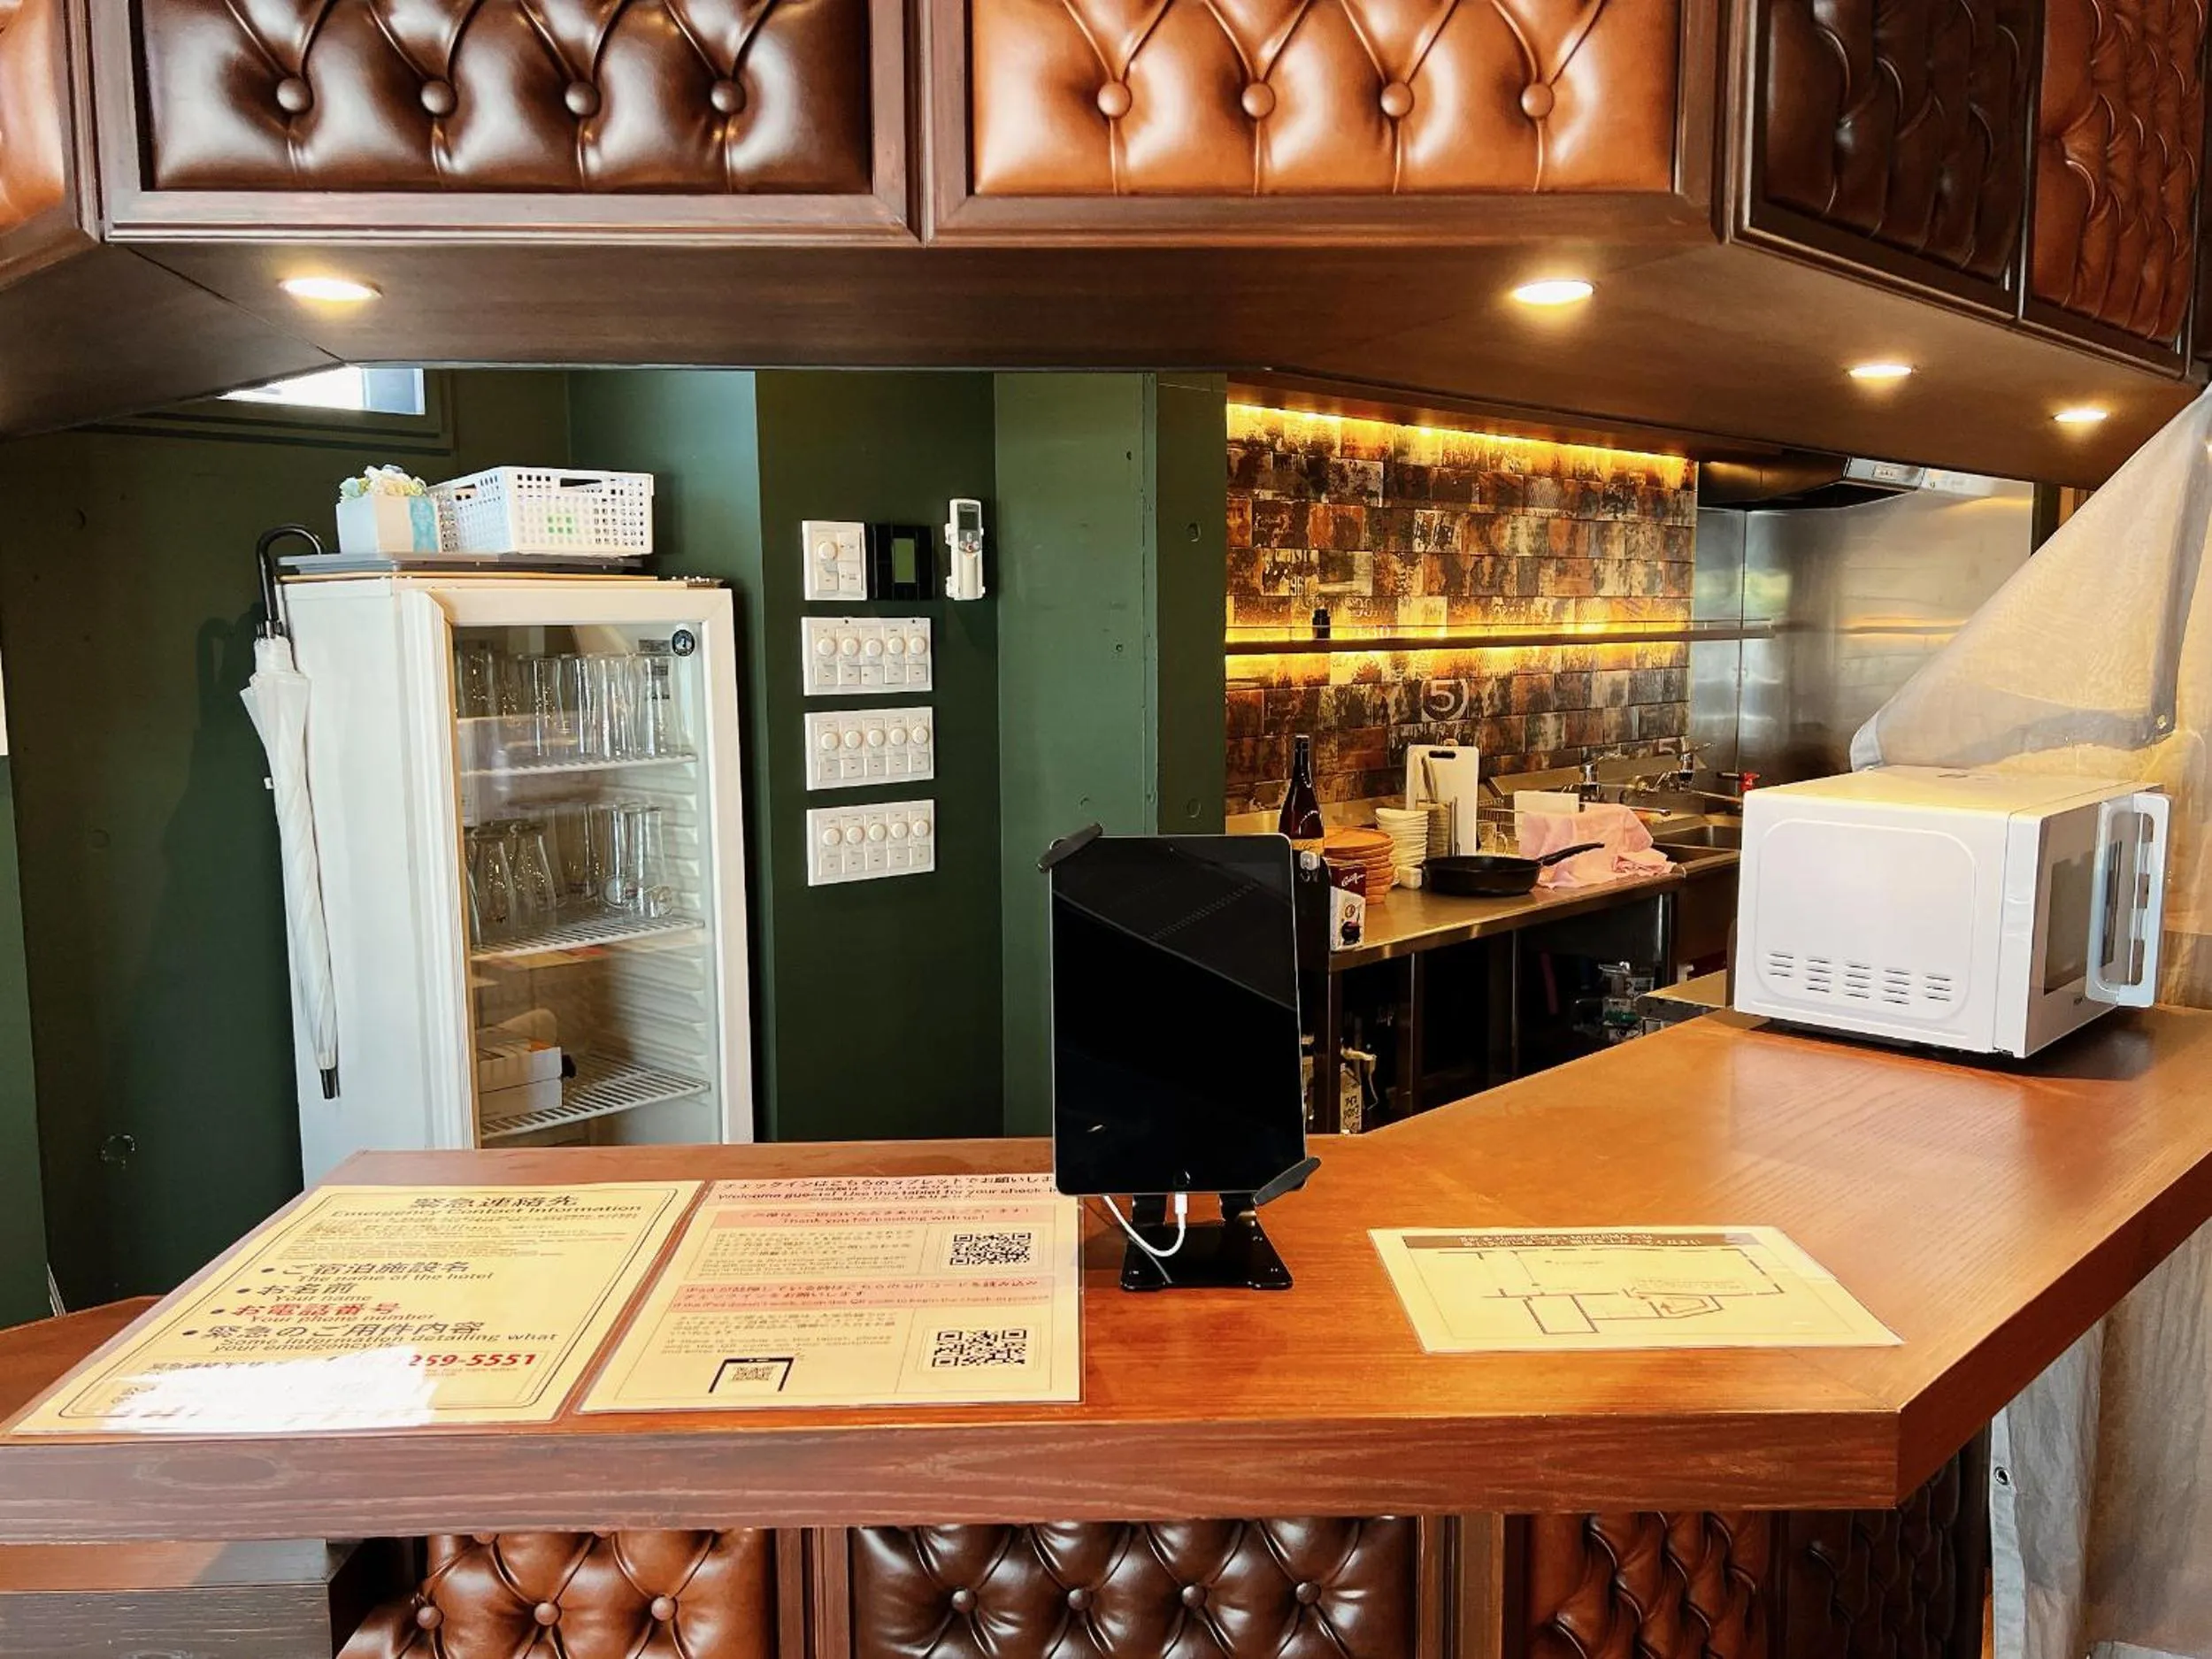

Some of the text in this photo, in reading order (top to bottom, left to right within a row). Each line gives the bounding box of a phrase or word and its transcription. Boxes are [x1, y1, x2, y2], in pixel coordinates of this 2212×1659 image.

[1430, 679, 1455, 712] 5
[725, 1176, 1050, 1188] チェックインはこちらのタブレットでお願いしま
[412, 1195, 579, 1209] 緊急連絡先
[281, 1261, 470, 1275] ご宿泊施設名
[257, 1282, 355, 1294] お名前
[231, 1302, 400, 1317] お電話番号
[205, 1321, 486, 1339] 緊急のご用件内容
[260, 1341, 373, 1350] emergency
[283, 1335, 405, 1344] information
[408, 1333, 503, 1343] detailing
[504, 1333, 561, 1341] what
